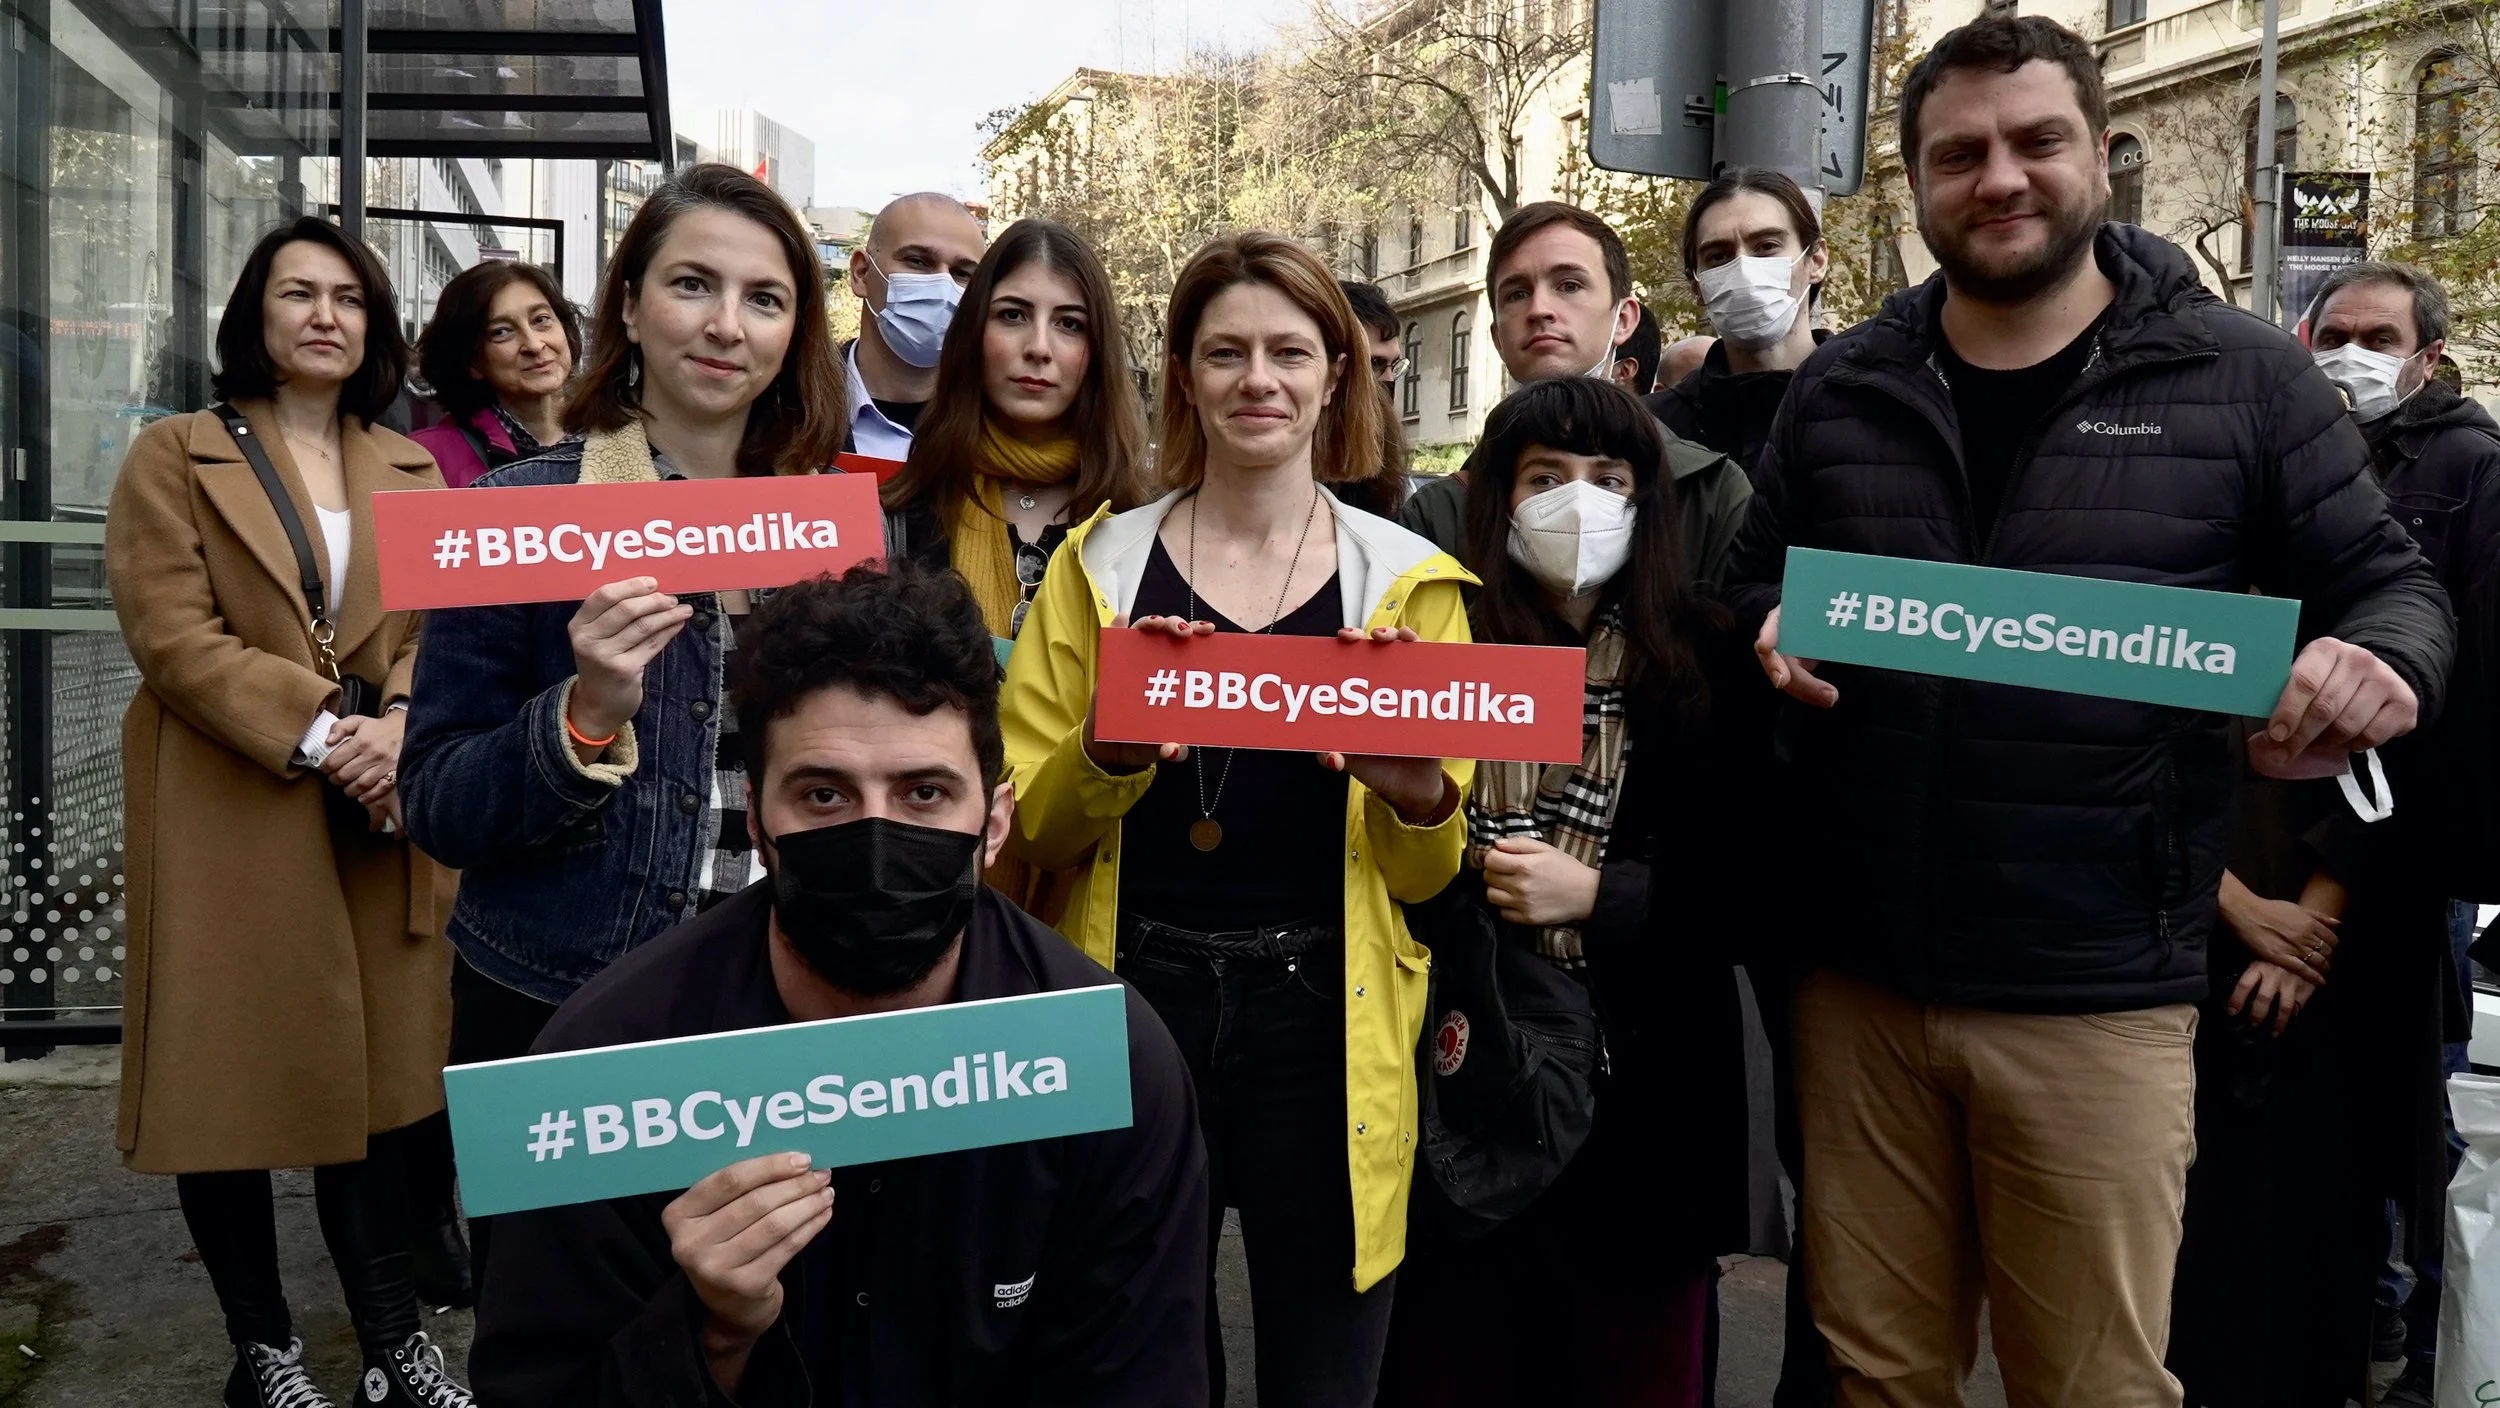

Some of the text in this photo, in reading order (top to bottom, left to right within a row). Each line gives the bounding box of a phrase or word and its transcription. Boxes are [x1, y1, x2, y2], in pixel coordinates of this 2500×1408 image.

[2093, 422, 2162, 435] Columbia
[433, 512, 838, 570] #BBCyeSendika
[1826, 592, 2235, 674] #BBCyeSendika
[1145, 670, 1534, 723] #BBCyeSendika
[527, 1051, 1067, 1161] #BBCyeSendika
[996, 1293, 1029, 1308] adida
